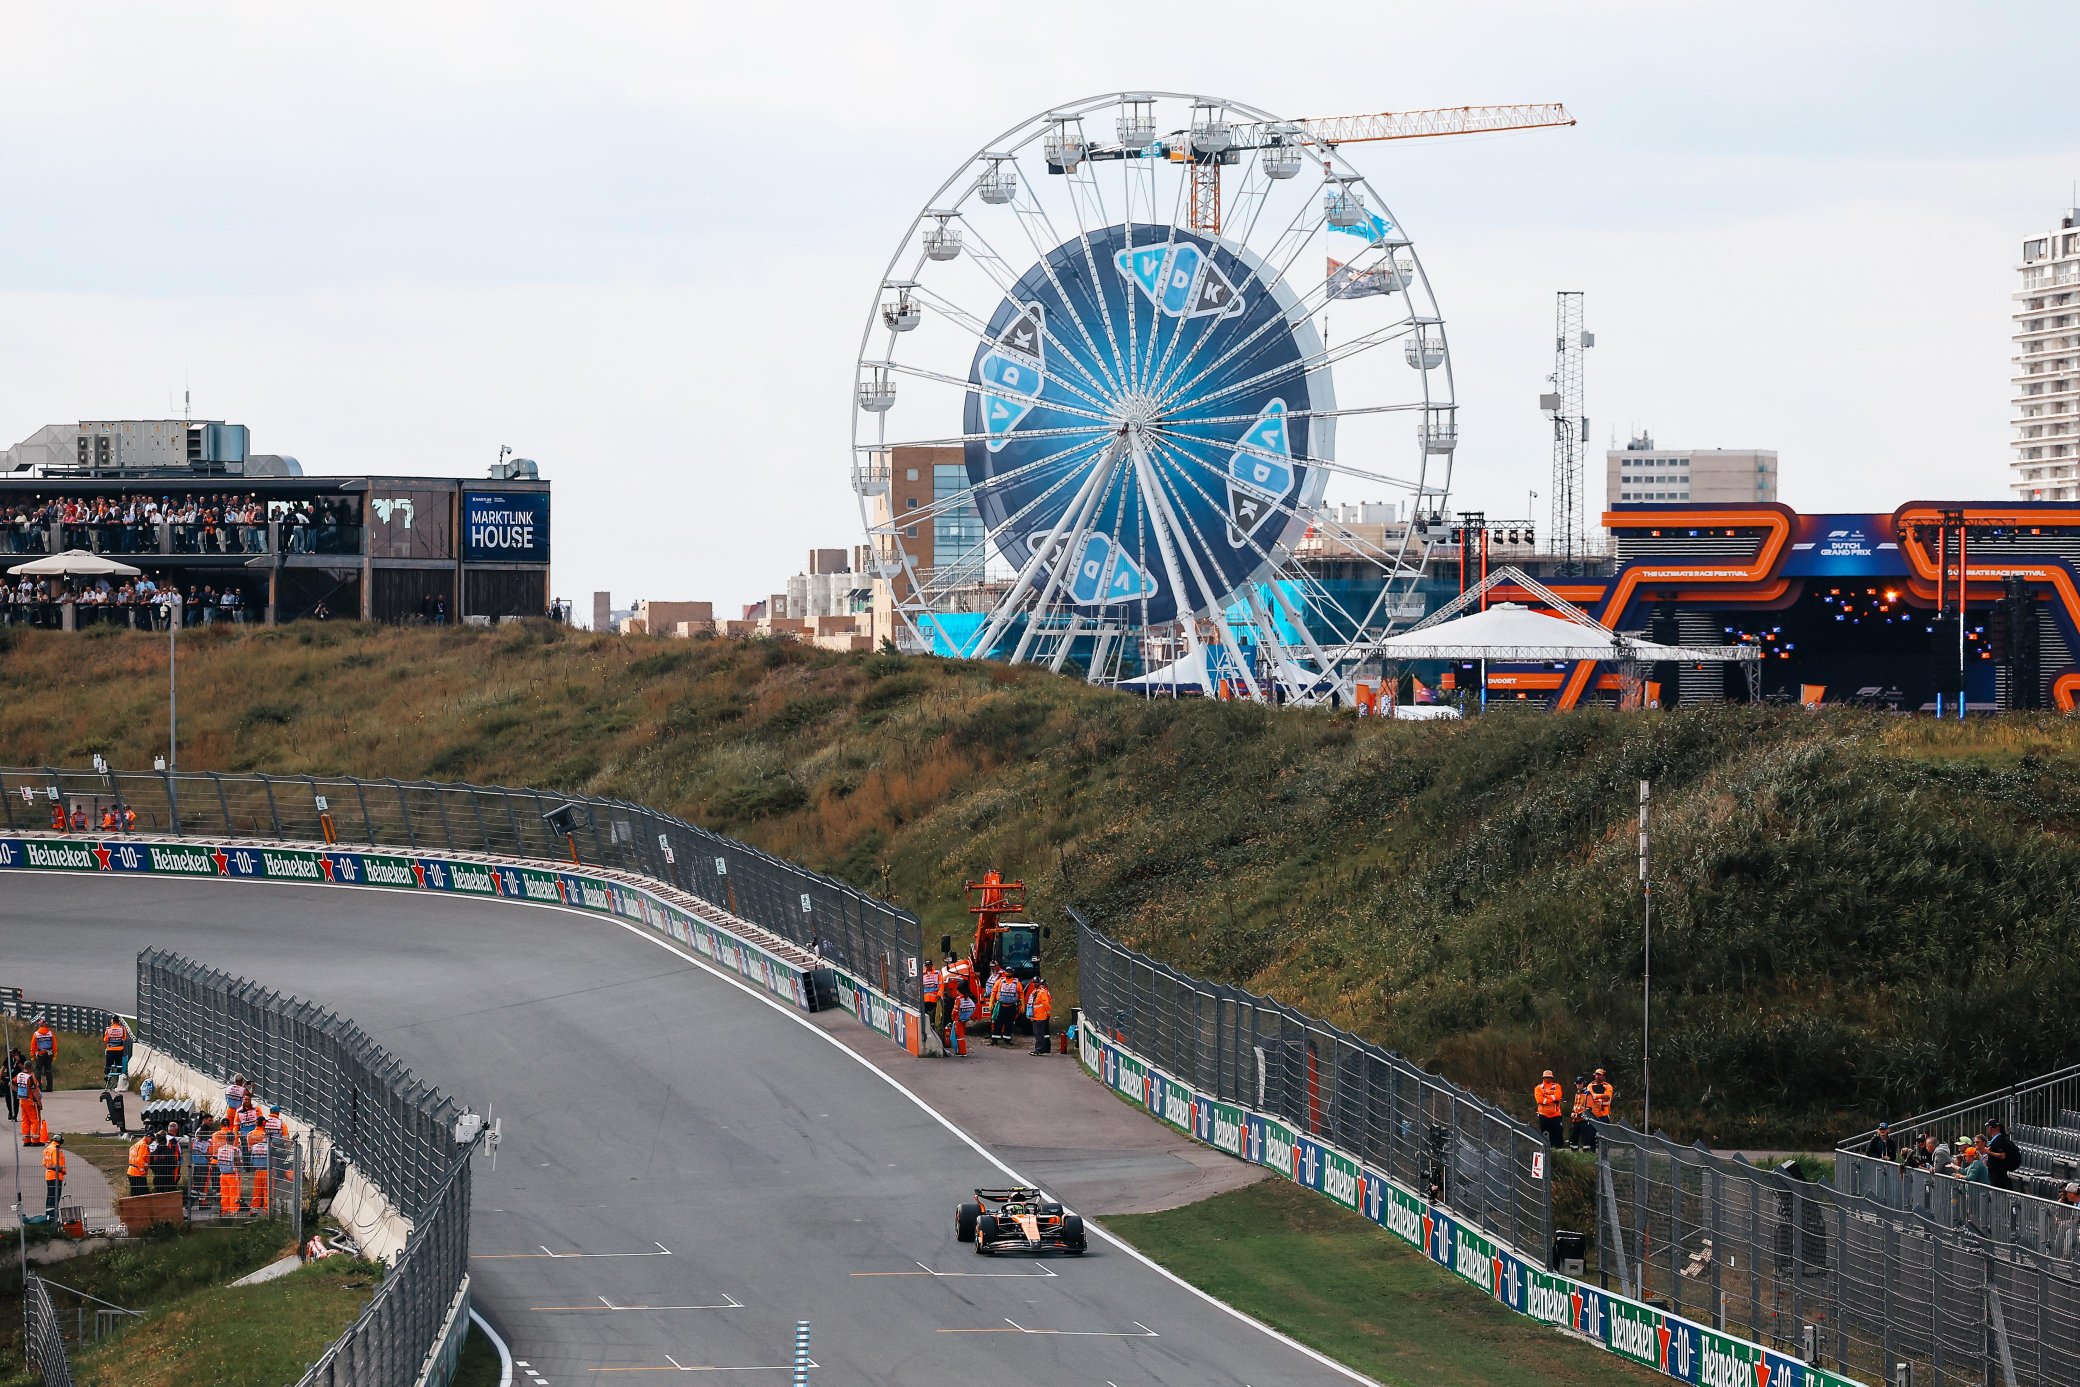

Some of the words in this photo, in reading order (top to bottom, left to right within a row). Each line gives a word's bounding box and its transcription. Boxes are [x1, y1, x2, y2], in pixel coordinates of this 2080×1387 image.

[472, 510, 534, 524] MARKTLINK
[472, 526, 534, 548] HOUSE
[0, 843, 12, 865] .0
[26, 844, 92, 867] Heineken
[120, 846, 138, 868] 0.0
[151, 848, 211, 872] Heineken
[236, 851, 252, 874] 0.0
[264, 854, 319, 878] Heineken
[339, 858, 354, 880] 0.0
[364, 859, 412, 884] Heineken
[430, 864, 444, 887] 0.0
[450, 866, 492, 892] Heineken
[522, 874, 558, 900] Heineken
[1118, 1056, 1143, 1103] Heineken
[1165, 1083, 1190, 1128] Heineken
[1214, 1108, 1240, 1154] Heineken
[1266, 1125, 1292, 1174] Heineken
[1306, 1146, 1316, 1186] 0.0
[1324, 1154, 1356, 1206] Heineken
[1370, 1177, 1380, 1220] 0.0
[1387, 1186, 1421, 1246] Heineken
[1438, 1218, 1450, 1264] 0.0
[1456, 1230, 1490, 1290] Heineken
[1507, 1260, 1518, 1307] 0.0
[1526, 1270, 1569, 1326] Heineken
[1588, 1292, 1600, 1336] 0.0
[1610, 1302, 1655, 1362] Heineken
[1678, 1326, 1690, 1377] 0.0
[1701, 1335, 1751, 1387] Heineken
